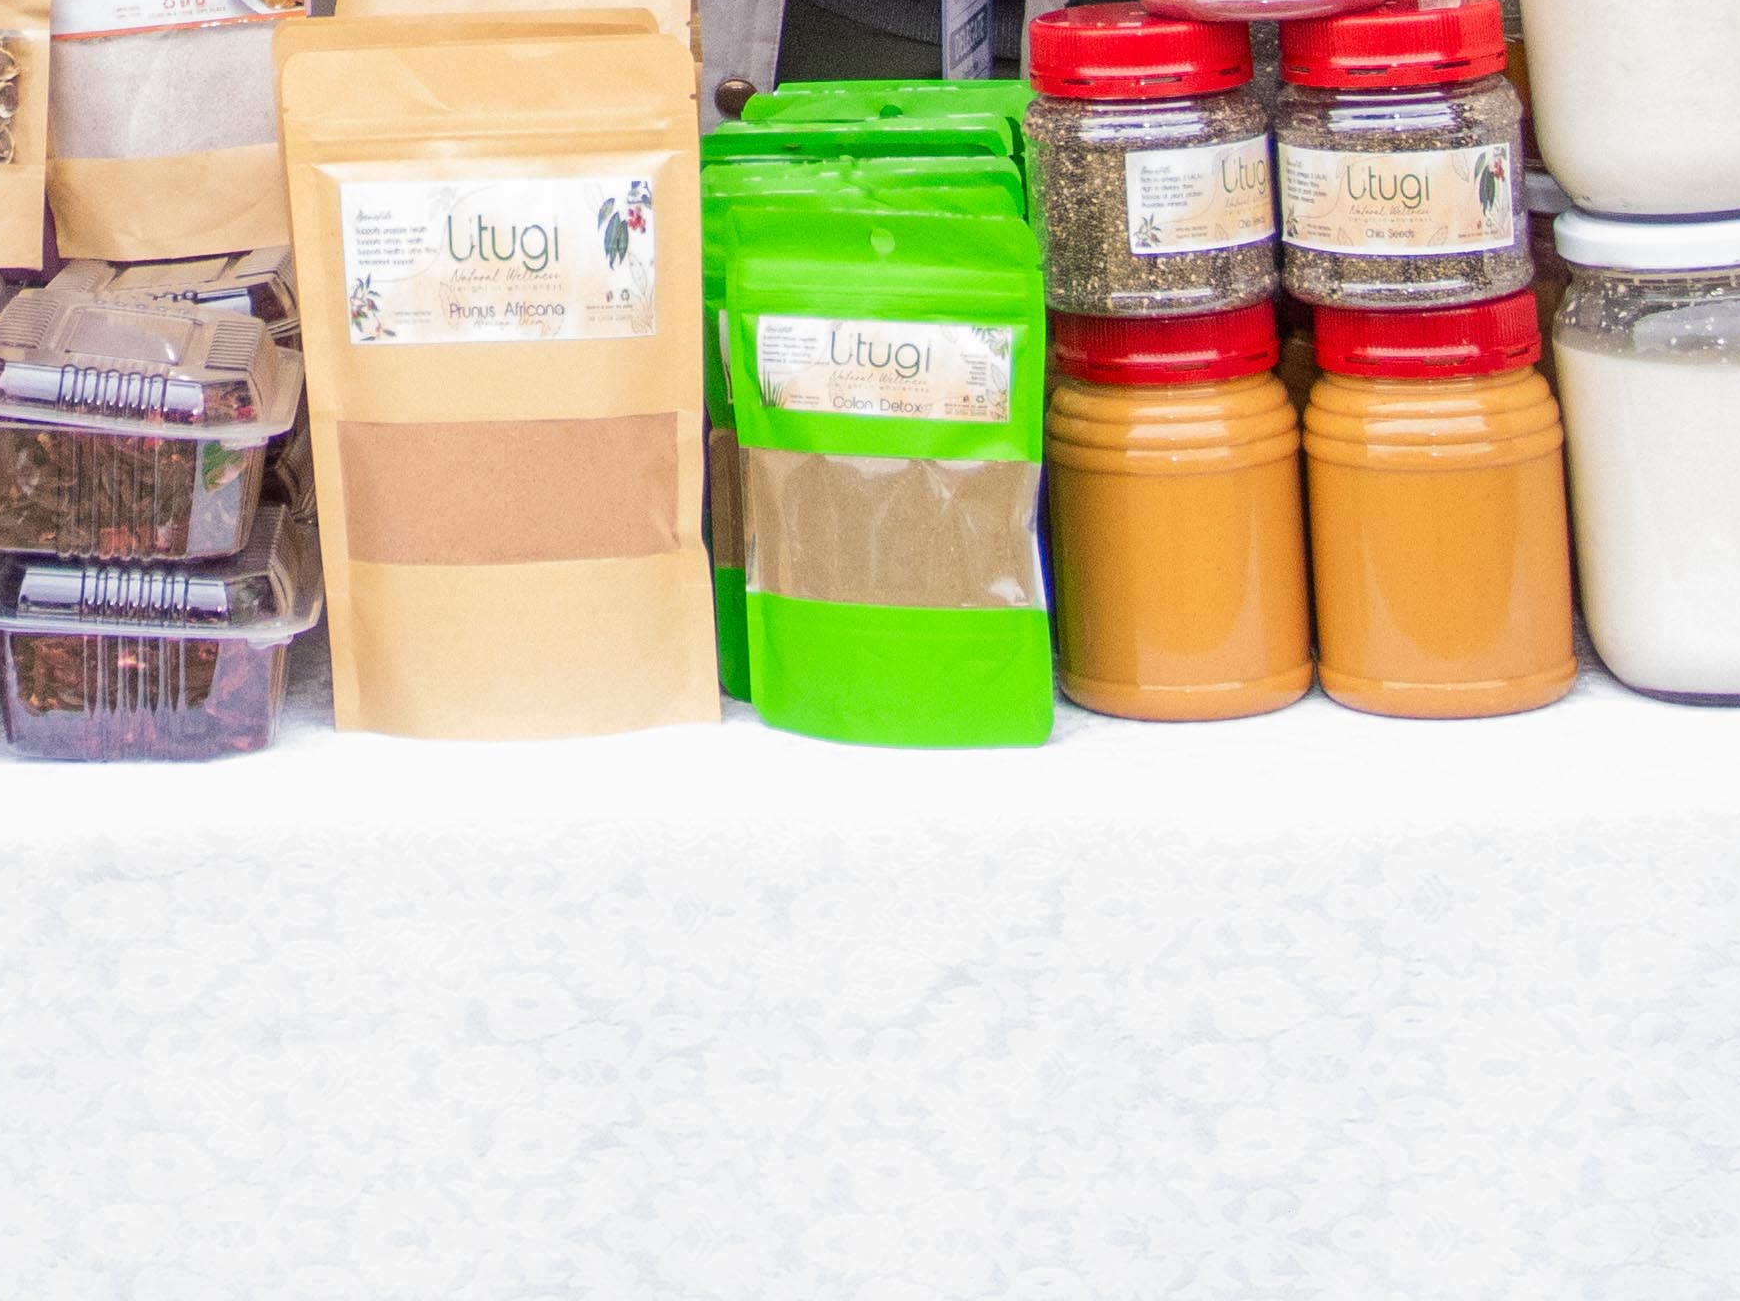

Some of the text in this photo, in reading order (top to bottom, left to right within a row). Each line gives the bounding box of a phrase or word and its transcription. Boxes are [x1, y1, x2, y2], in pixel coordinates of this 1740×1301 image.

[1347, 166, 1429, 210] Utugi
[447, 214, 559, 273] Utugi
[1366, 228, 1415, 239] Chia Seeds
[449, 301, 565, 318] Prunus Africana
[831, 330, 930, 379] Utugi
[832, 395, 922, 414] Colon Detox
